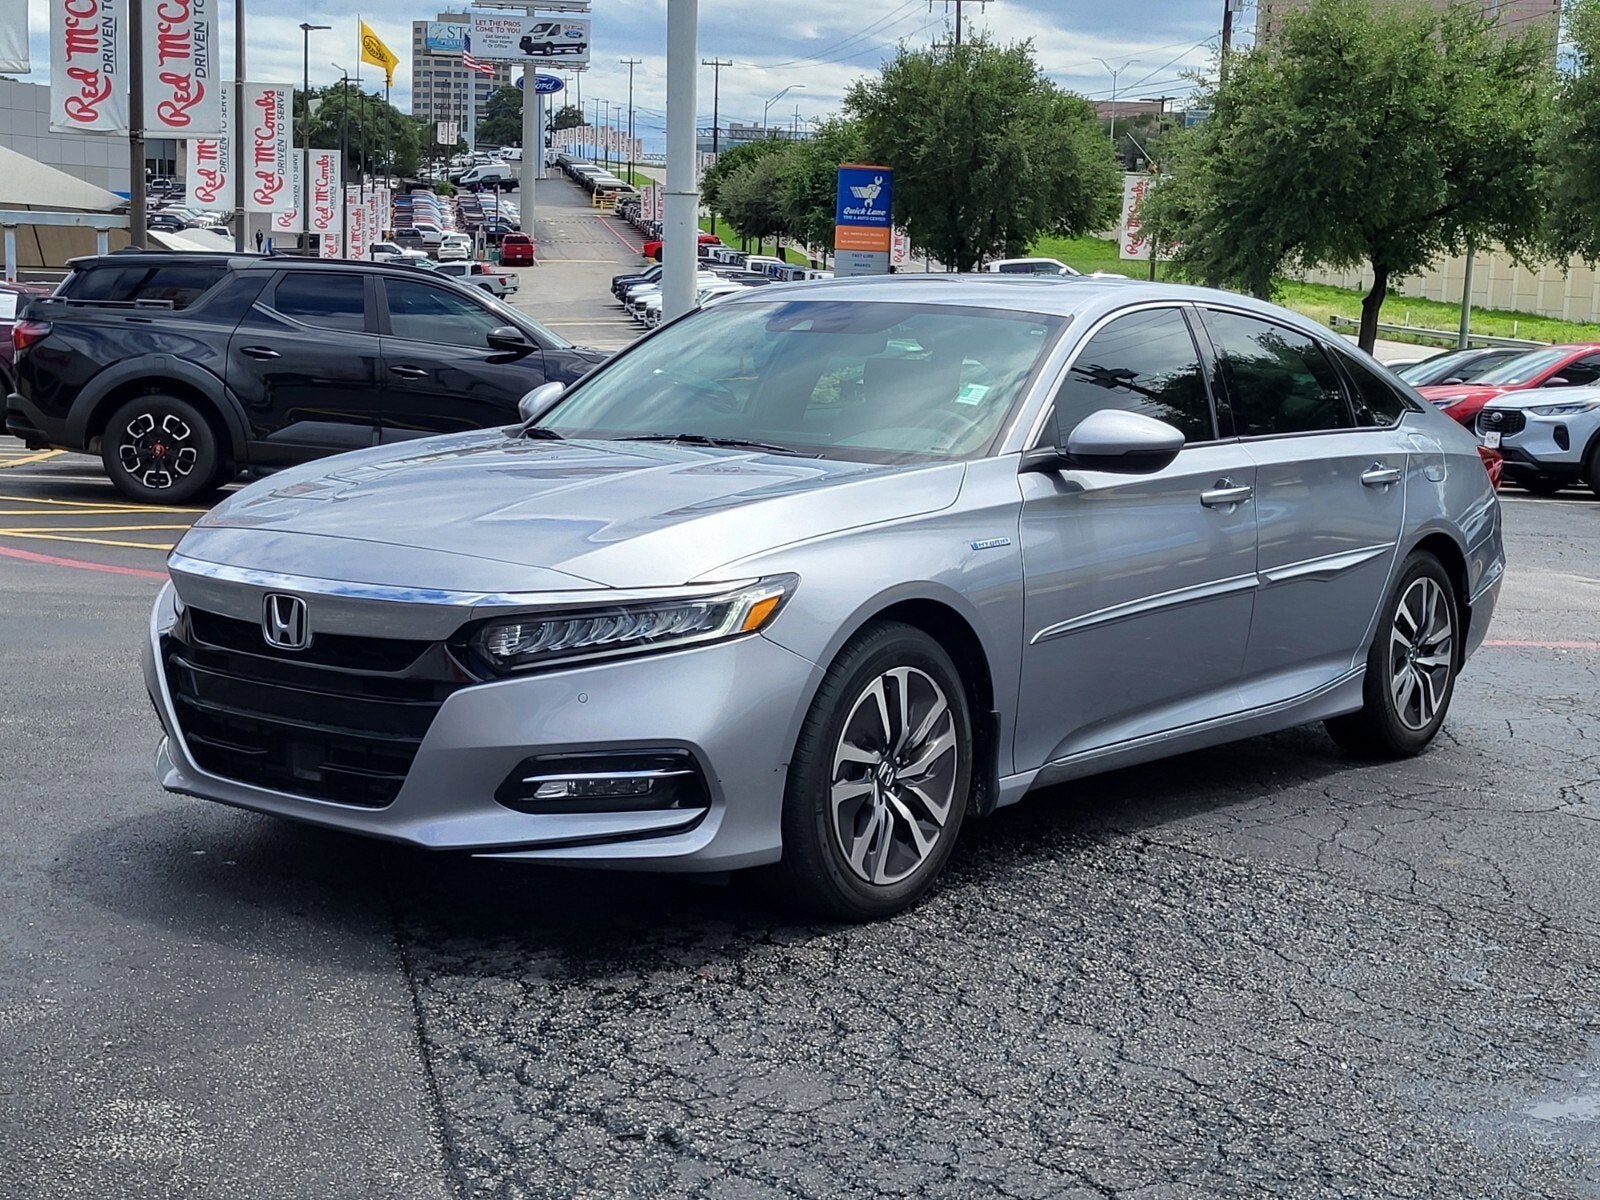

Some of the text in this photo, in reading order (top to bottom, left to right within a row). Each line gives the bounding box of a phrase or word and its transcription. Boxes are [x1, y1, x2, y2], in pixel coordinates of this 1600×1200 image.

[64, 0, 112, 122] Red McC
[102, 17, 114, 74] DRIVEN
[157, 0, 204, 127] Red McC
[194, 21, 206, 78] DRIVEN
[219, 137, 227, 173] DRIVEN
[253, 89, 284, 205] Red McCombs
[276, 90, 285, 176] DRIVEN TO SERVE
[194, 168, 226, 203] Red
[329, 176, 336, 184] TO
[277, 208, 297, 227] Re
[314, 206, 334, 229] Red
[843, 206, 887, 216] Quick Lane
